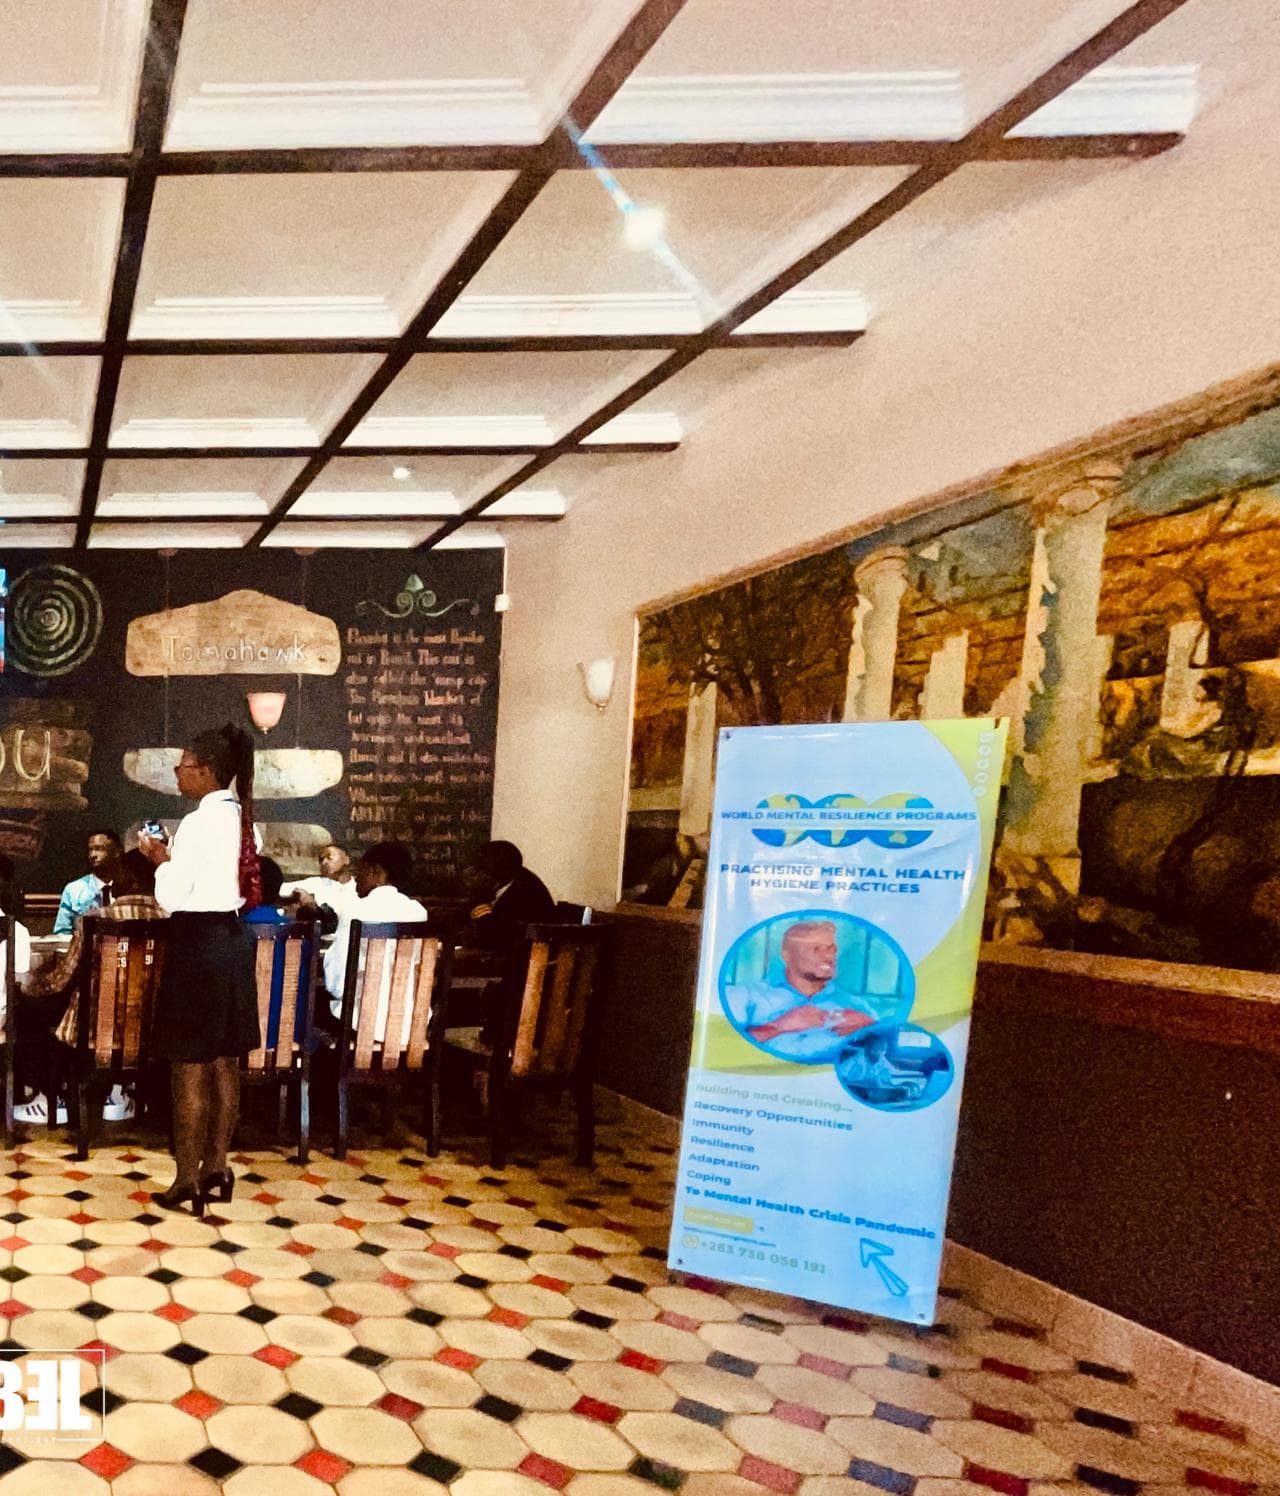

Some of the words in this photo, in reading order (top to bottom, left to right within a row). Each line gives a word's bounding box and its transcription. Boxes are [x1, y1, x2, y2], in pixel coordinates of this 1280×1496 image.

[162, 632, 307, 664] Tomahawk
[721, 810, 763, 821] WORLD
[766, 810, 816, 821] MENTAL
[820, 810, 892, 821] RESILIENCE
[896, 811, 978, 822] PROGRAMS
[720, 863, 815, 877] PRACTISING
[820, 866, 889, 879] MENTAL
[895, 868, 967, 881] HEALTH
[750, 878, 819, 891] HYGIENE
[825, 880, 921, 894] PRACTICES
[696, 1082, 750, 1099] Building
[753, 1092, 779, 1102] and
[694, 1101, 753, 1118] Recovery
[756, 1109, 853, 1131] Opportunities
[692, 1118, 755, 1136] Immunity
[690, 1135, 756, 1153] Resilience
[688, 1152, 760, 1172] Adaptation
[686, 1169, 732, 1186] Coping
[685, 1185, 700, 1196] To
[704, 1189, 752, 1206] Mental
[755, 1199, 805, 1216] Health
[808, 1207, 852, 1225] Crisis
